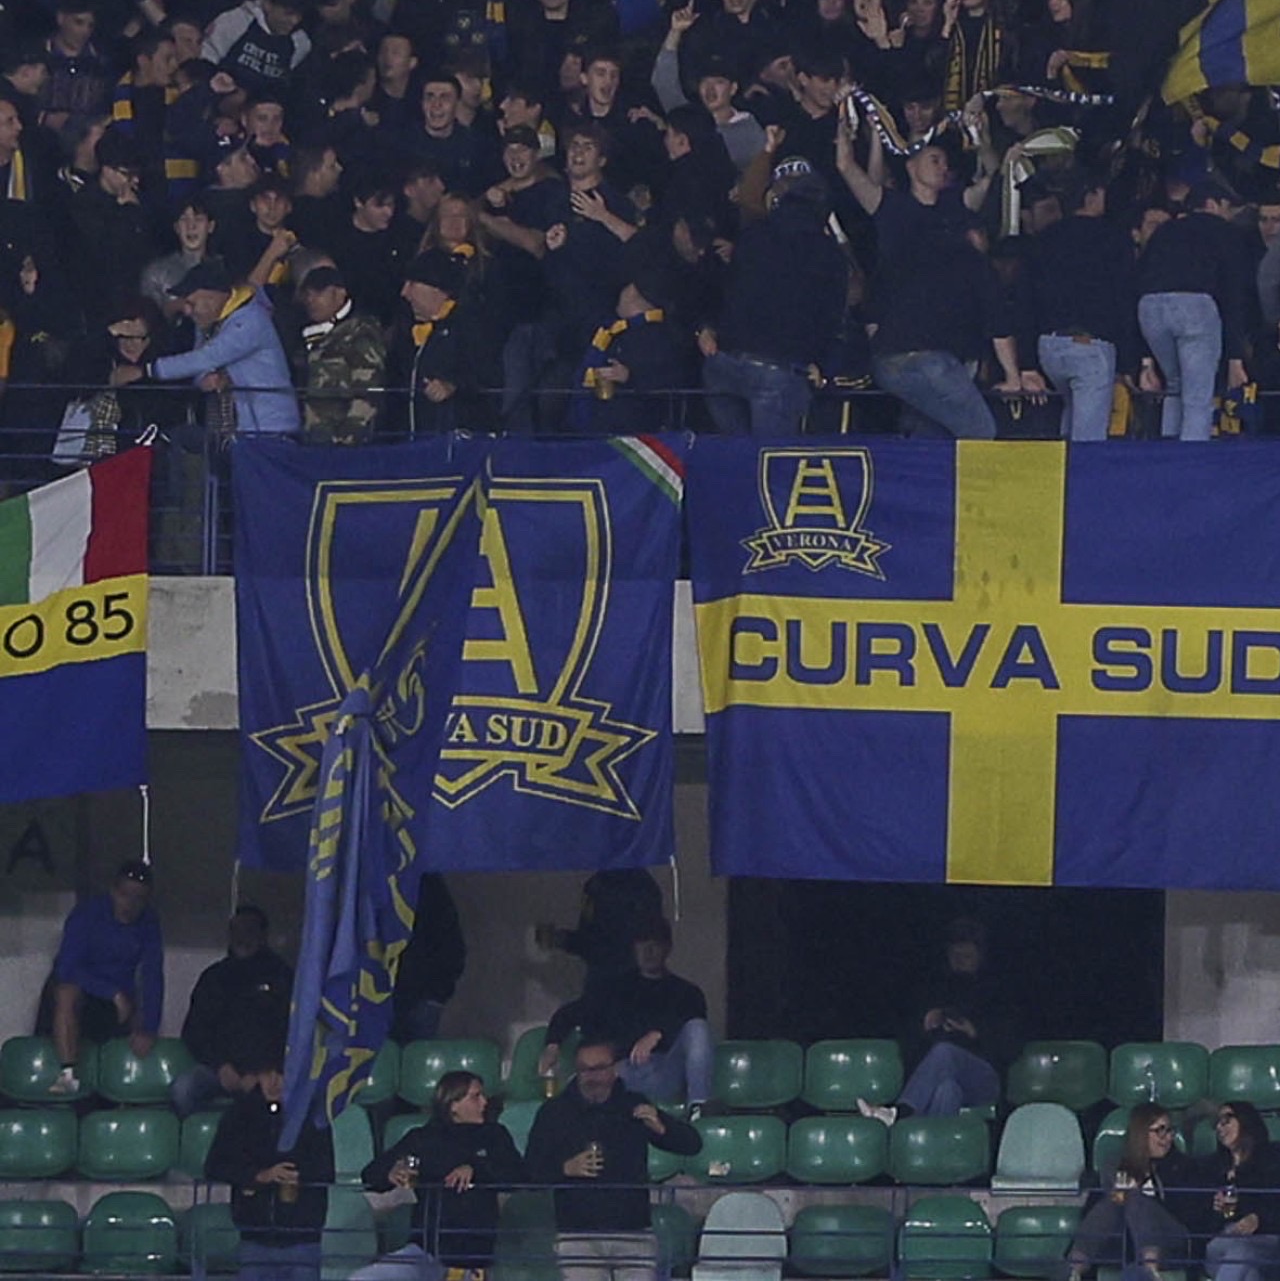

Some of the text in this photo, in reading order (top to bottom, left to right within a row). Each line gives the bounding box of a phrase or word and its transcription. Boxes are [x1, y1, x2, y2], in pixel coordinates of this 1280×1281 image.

[772, 530, 854, 553] VERONA
[64, 592, 135, 646] 85
[729, 615, 1060, 691] CURVA
[486, 713, 569, 751] SUD
